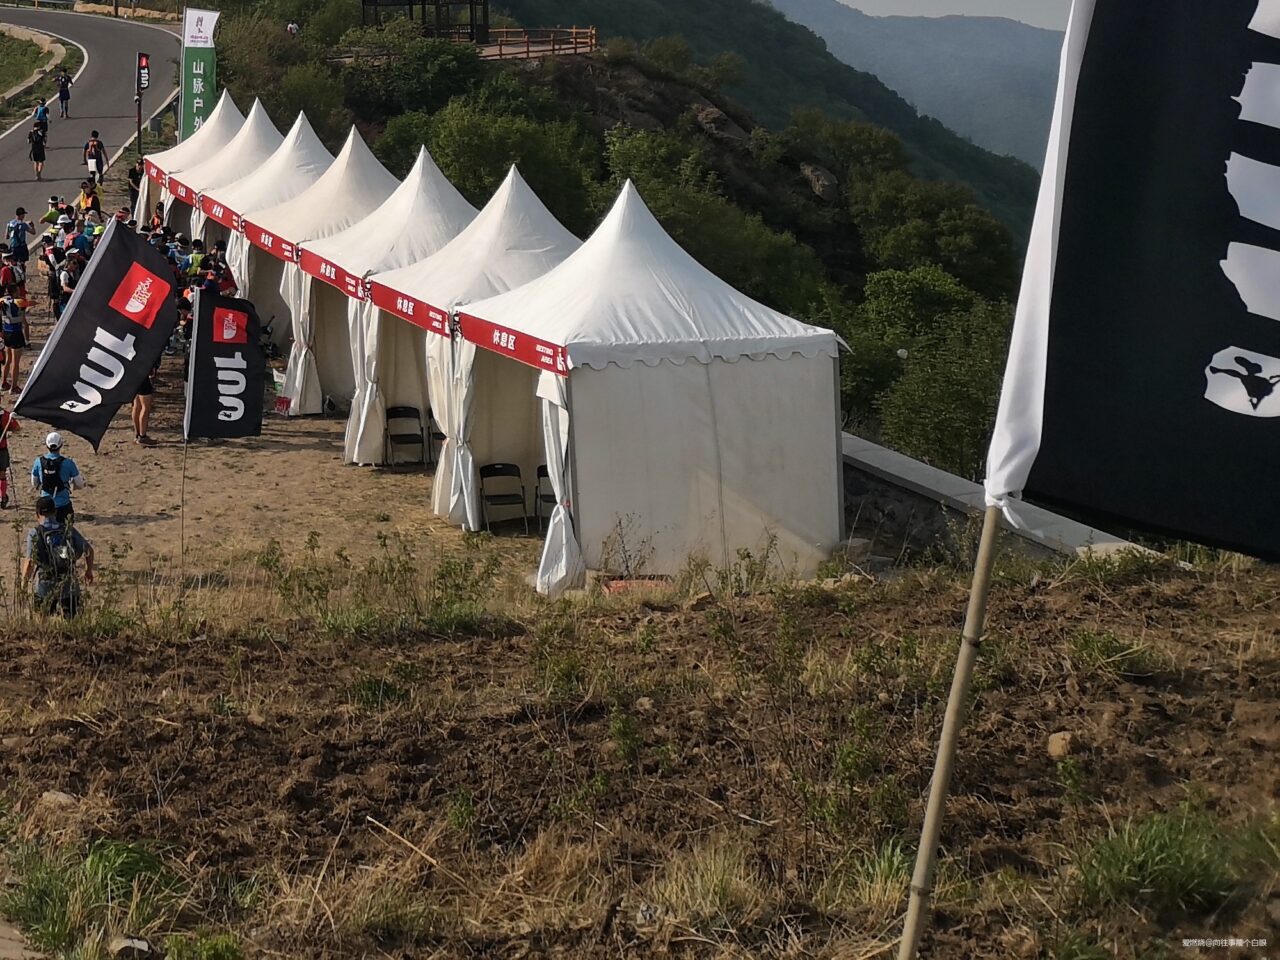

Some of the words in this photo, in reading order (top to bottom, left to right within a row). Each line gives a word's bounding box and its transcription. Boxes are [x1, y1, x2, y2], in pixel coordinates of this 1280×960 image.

[192, 58, 205, 132] 山脉户外
[492, 328, 516, 351] 休息区
[213, 351, 247, 422] 100
